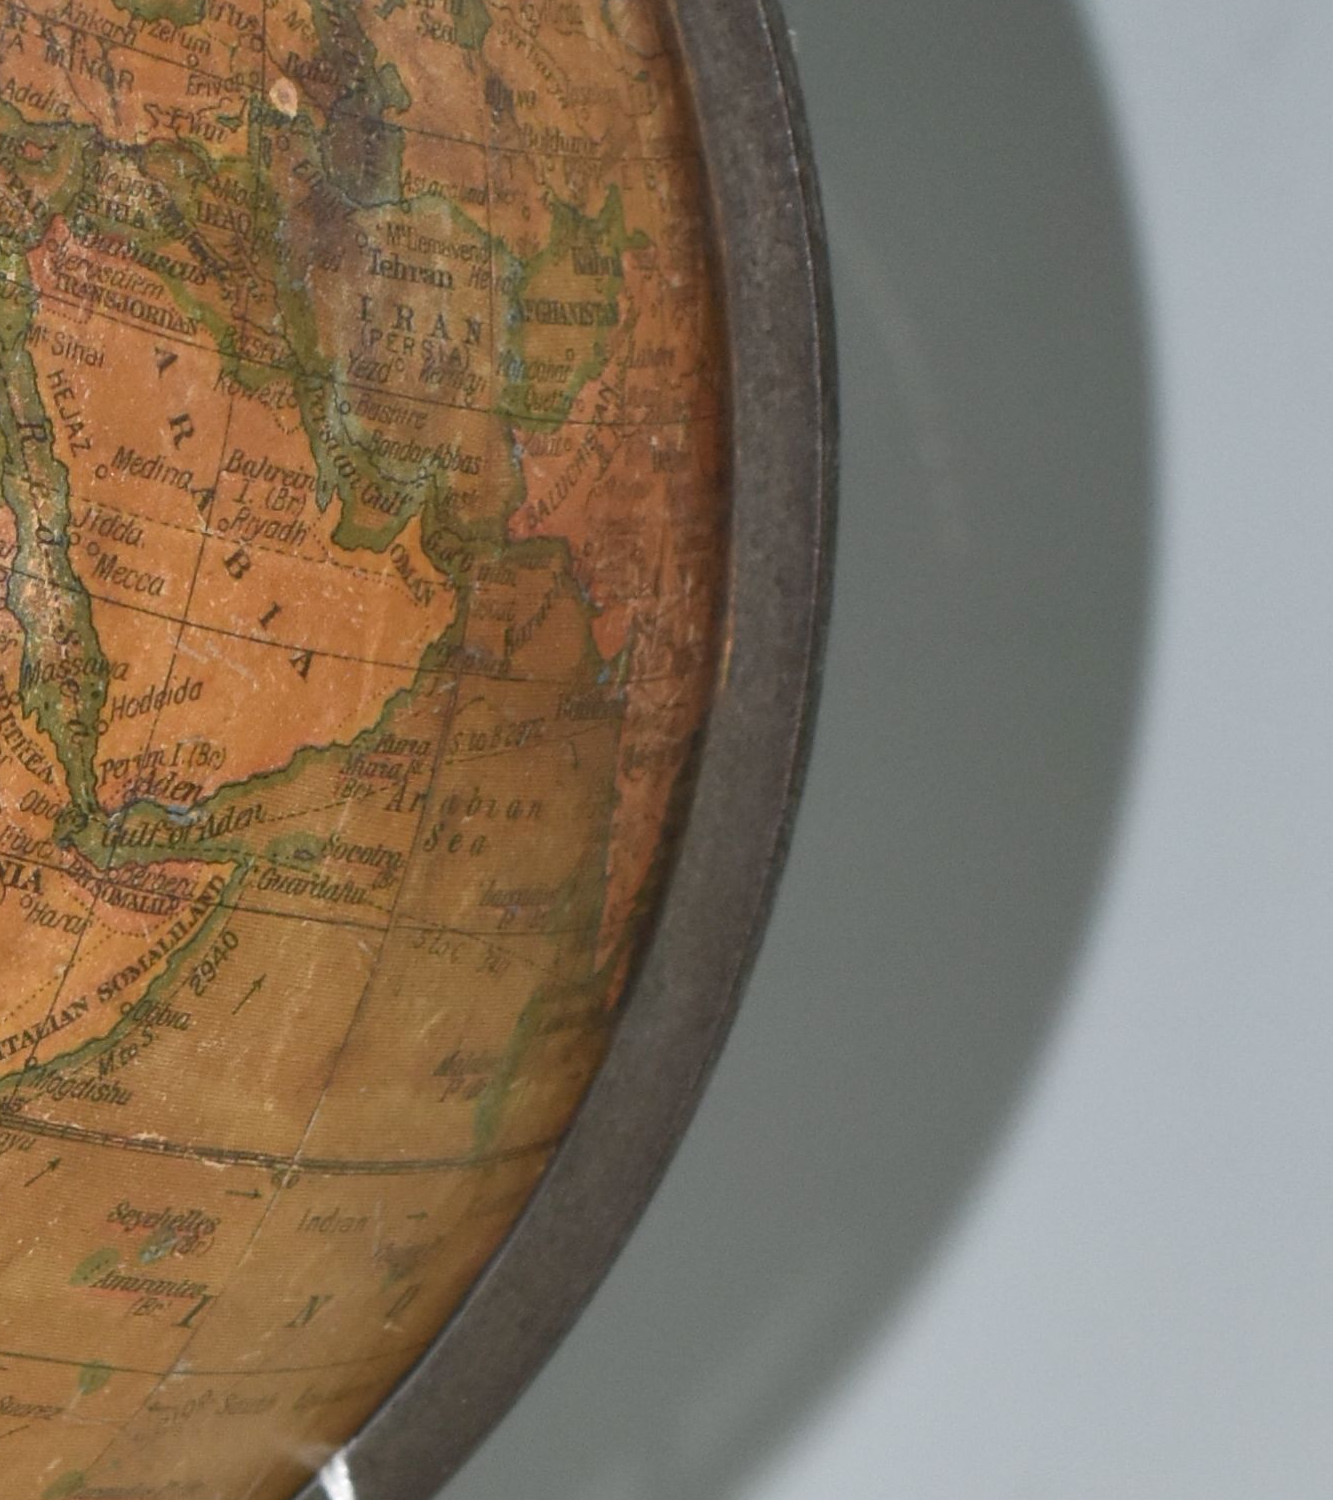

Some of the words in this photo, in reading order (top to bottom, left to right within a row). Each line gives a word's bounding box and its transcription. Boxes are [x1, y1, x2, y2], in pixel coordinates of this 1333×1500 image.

[49, 242, 165, 301] Jerusalem
[48, 369, 92, 458] HEJAZ
[111, 446, 194, 492] Medina
[231, 508, 307, 546] Riyadh
[94, 553, 165, 597] Mecca
[109, 678, 204, 723] Hodeida
[132, 772, 204, 802] Aden
[197, 803, 268, 842] Aden
[96, 873, 228, 1004] SOMALILAND
